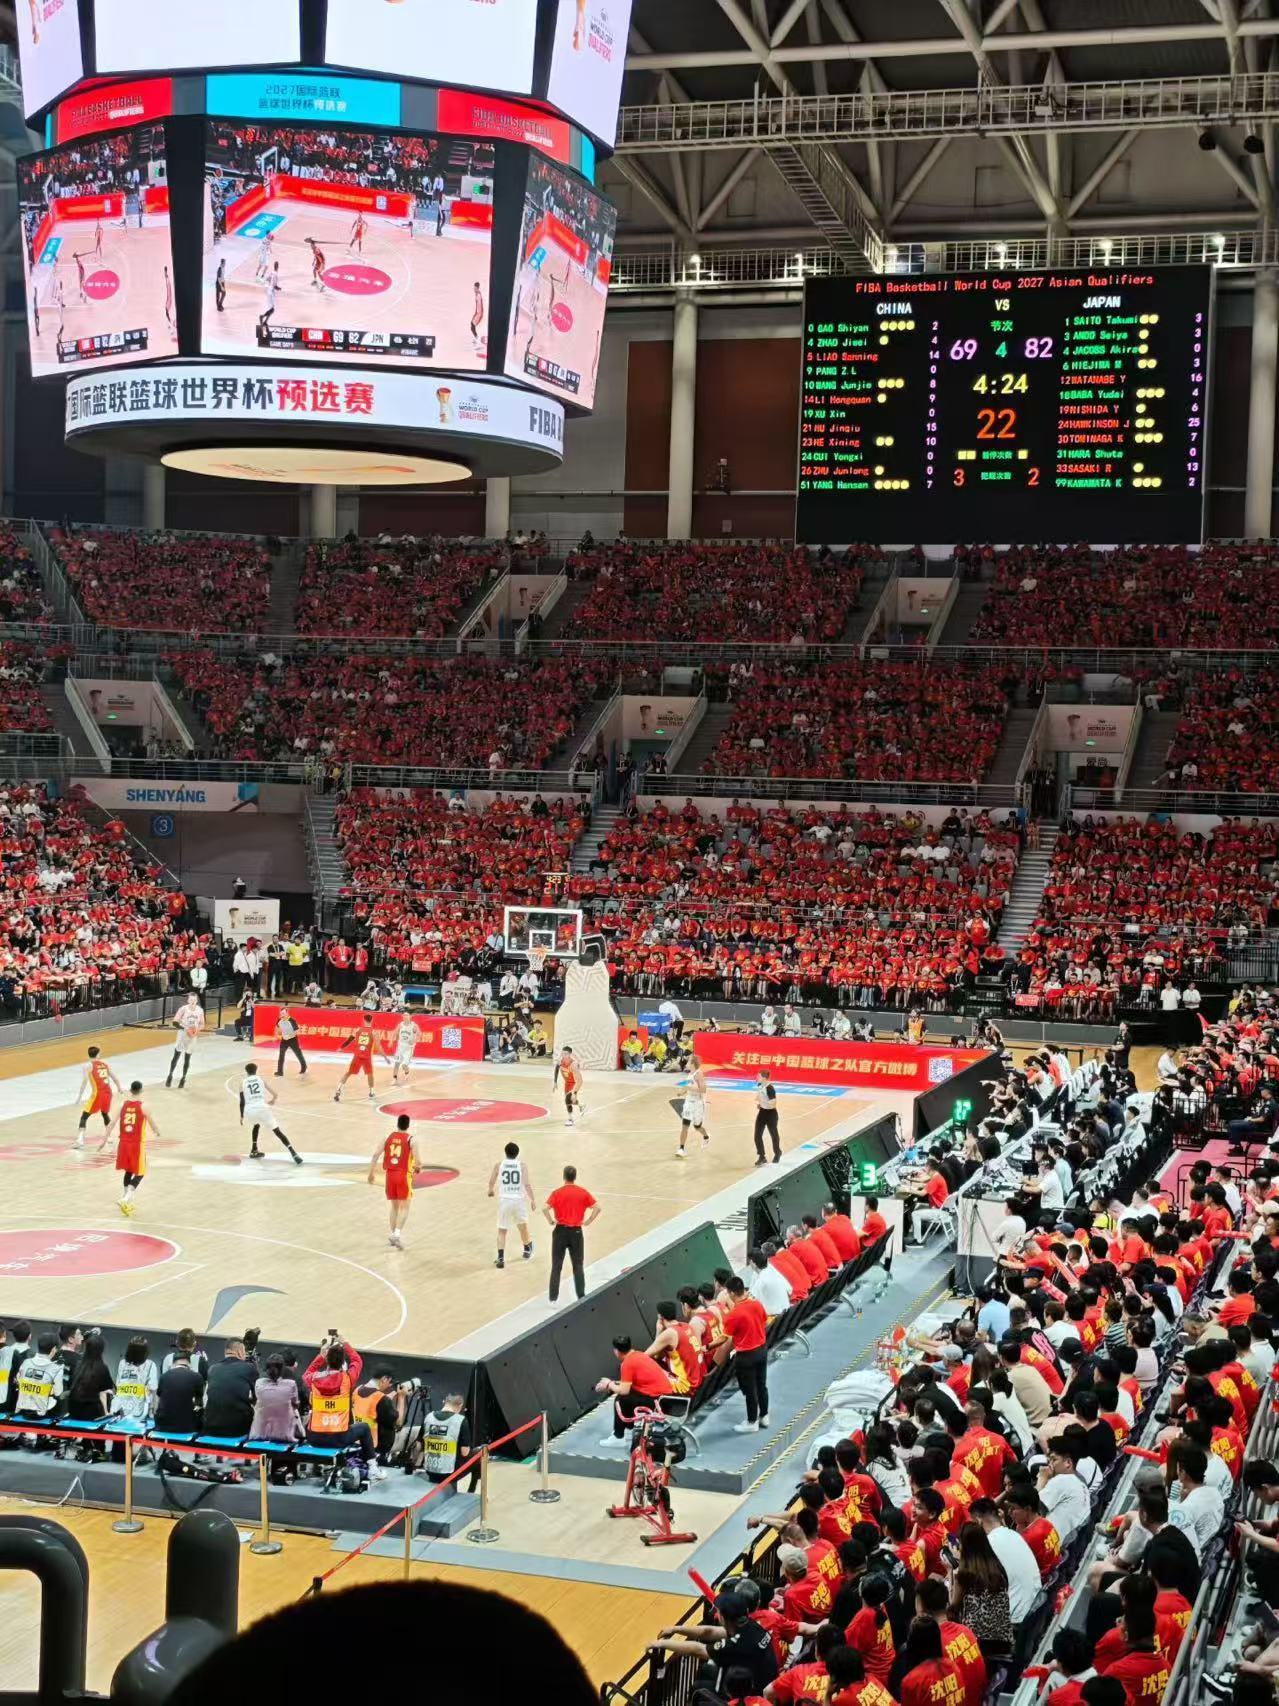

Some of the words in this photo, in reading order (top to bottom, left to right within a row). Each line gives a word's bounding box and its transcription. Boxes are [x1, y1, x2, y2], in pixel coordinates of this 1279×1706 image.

[856, 283, 881, 292] FIBA
[887, 281, 948, 292] Basketball
[954, 279, 987, 290] World
[992, 278, 1011, 290] Cup
[1018, 278, 1044, 288] 2027
[1049, 277, 1082, 287] Asian
[1088, 275, 1153, 286] Qualifiers
[876, 302, 912, 315] CHINA
[995, 298, 1010, 311] VS
[1083, 296, 1121, 308] JAPAN
[1065, 317, 1069, 326] 1
[1073, 316, 1101, 325] SAITO
[1195, 313, 1202, 322] 3
[838, 323, 869, 333] Shiyan
[932, 321, 938, 331] 2
[990, 320, 1013, 331] 节次
[1064, 332, 1069, 340] 3
[1195, 328, 1201, 338] 3
[808, 339, 813, 347] 4
[931, 336, 937, 344] 4
[950, 339, 978, 361] 69
[995, 341, 1007, 358] 4
[1024, 337, 1053, 359] 82
[1062, 347, 1069, 355] 4
[1194, 343, 1201, 352] 0
[807, 353, 813, 361] 5
[817, 353, 837, 361] LIAO
[929, 351, 940, 359] 14
[1062, 362, 1069, 370] 6
[1193, 358, 1200, 367] 3
[806, 367, 812, 375] 9
[930, 365, 936, 374] 0
[973, 373, 1028, 394] 4:24
[1060, 375, 1070, 384] 12
[1191, 373, 1202, 382] 16
[805, 381, 814, 390] 10
[930, 380, 936, 388] 8
[1192, 389, 1198, 397] 4
[804, 395, 814, 404] 14
[815, 395, 825, 404] LI
[929, 394, 936, 403] 9
[804, 410, 813, 418] 19
[815, 410, 826, 418] XU
[830, 410, 846, 418] Xin
[929, 409, 935, 417] 0
[1059, 405, 1069, 414] 19
[1191, 403, 1198, 412] 6
[529, 405, 556, 439] FIBA
[803, 424, 812, 432] 21
[927, 423, 937, 431] 15
[976, 408, 1016, 439] 22
[1058, 420, 1069, 429] 24
[1187, 418, 1200, 427] 25
[803, 438, 813, 447] 23
[813, 438, 824, 446] HE
[926, 438, 936, 446] 10
[1057, 435, 1069, 443] 30
[1191, 433, 1197, 441] 7
[802, 453, 812, 461] 24
[927, 452, 934, 460] 0
[1057, 449, 1068, 458] 31
[1189, 448, 1196, 456] 0
[801, 467, 812, 475] 26
[927, 466, 933, 474] 0
[1056, 464, 1067, 473] 33
[1068, 463, 1100, 473] SASAKI
[1105, 463, 1112, 472] R
[1187, 462, 1199, 471] 13
[953, 468, 965, 486] 3
[1028, 468, 1039, 485] 2
[801, 481, 810, 489] 51
[927, 480, 933, 489] 7
[1055, 479, 1067, 487] 99
[1189, 478, 1195, 486] 2
[126, 788, 206, 803] SHENYANG
[159, 819, 168, 832] 3
[247, 1082, 260, 1095] 12
[124, 1112, 136, 1125] 21
[389, 1143, 402, 1158] 14
[501, 1170, 520, 1184] 30
[21, 1383, 41, 1394] PHOTO
[118, 1385, 138, 1395] PHOTO
[324, 1401, 336, 1409] RH
[427, 1441, 448, 1452] PHOTO
